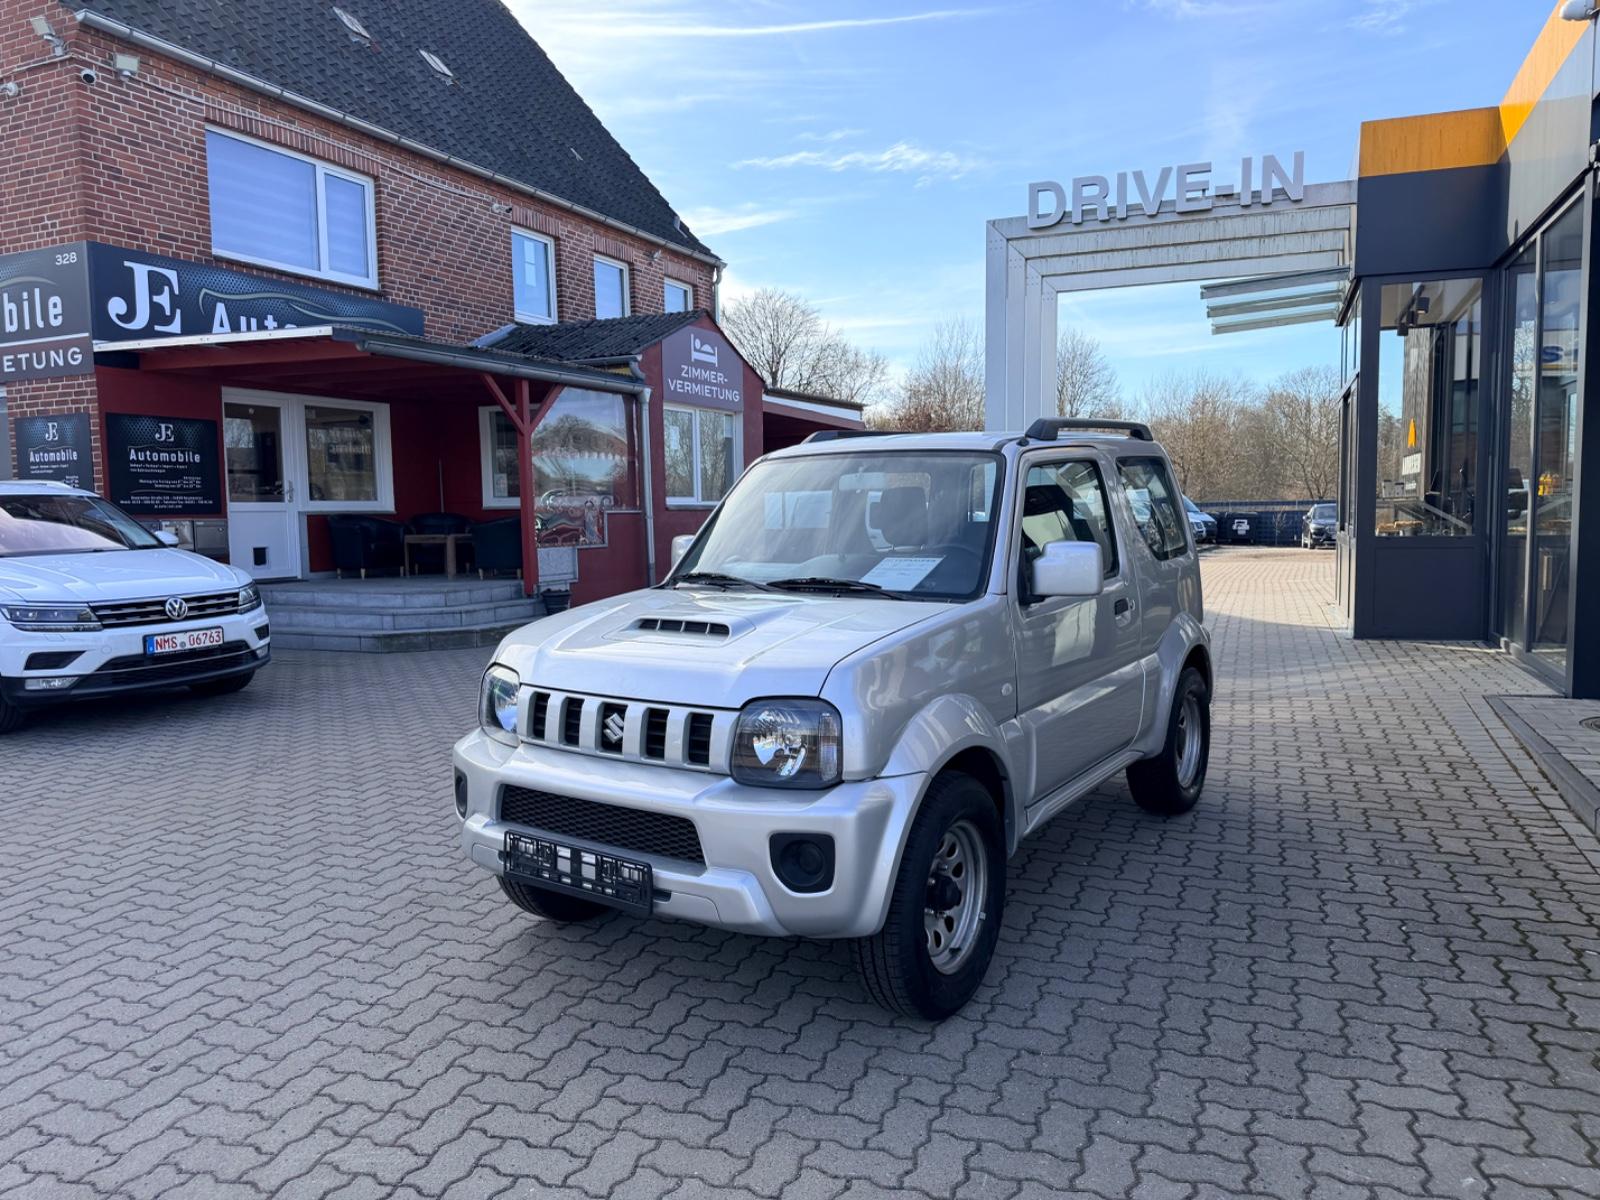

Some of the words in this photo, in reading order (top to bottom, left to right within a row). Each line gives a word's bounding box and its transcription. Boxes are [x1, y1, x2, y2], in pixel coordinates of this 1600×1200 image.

[1027, 151, 1305, 230] DRIVE-IN
[55, 252, 78, 266] 328
[3, 287, 63, 333] bile
[211, 302, 298, 334] Aut
[2, 346, 82, 373] ETUNG
[680, 364, 729, 385] ZIMMER-
[668, 378, 740, 402] VERMIETUNG
[29, 448, 78, 463] Automobile
[129, 448, 201, 463] Automobile
[155, 636, 178, 650] NMS
[188, 630, 221, 646] 06763
